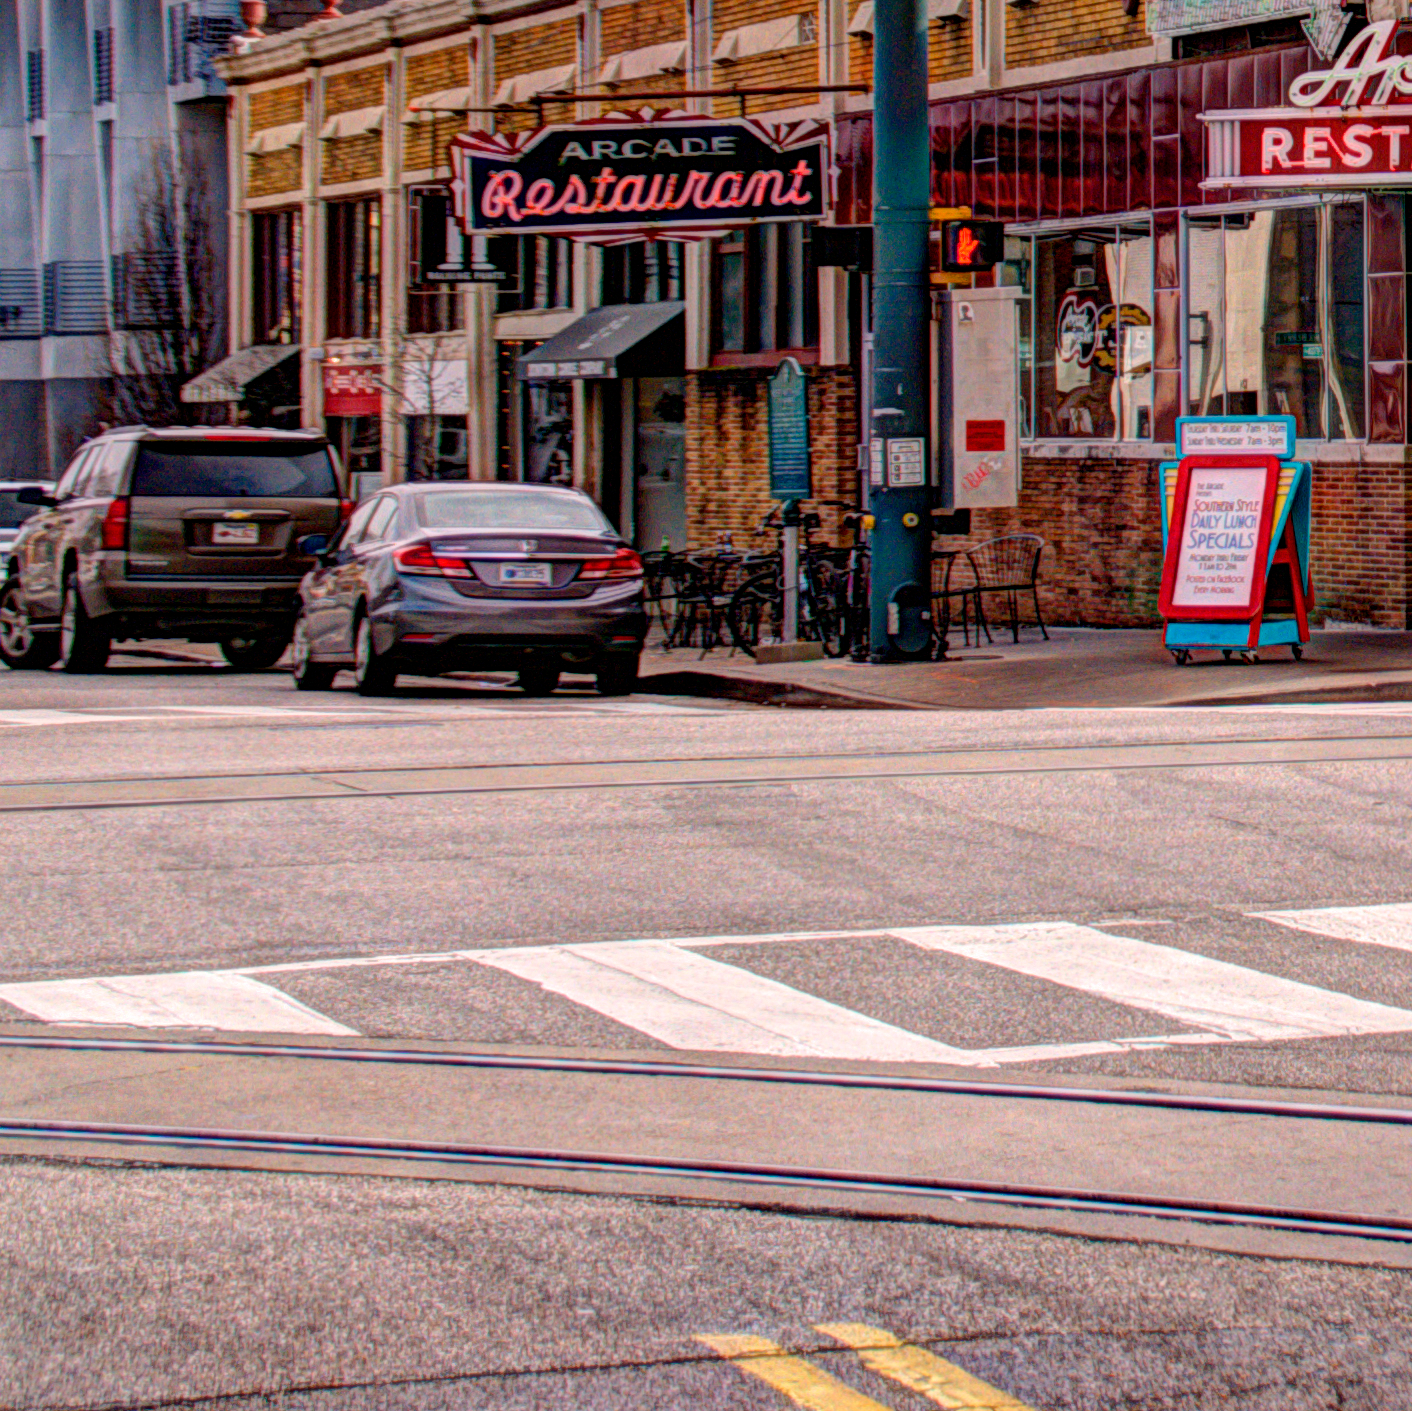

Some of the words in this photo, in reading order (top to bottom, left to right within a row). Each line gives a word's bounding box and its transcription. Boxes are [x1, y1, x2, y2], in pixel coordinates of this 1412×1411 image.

[560, 137, 738, 163] ARCADE
[481, 160, 812, 221] Restaurant
[1187, 530, 1255, 549] SPECIALS
